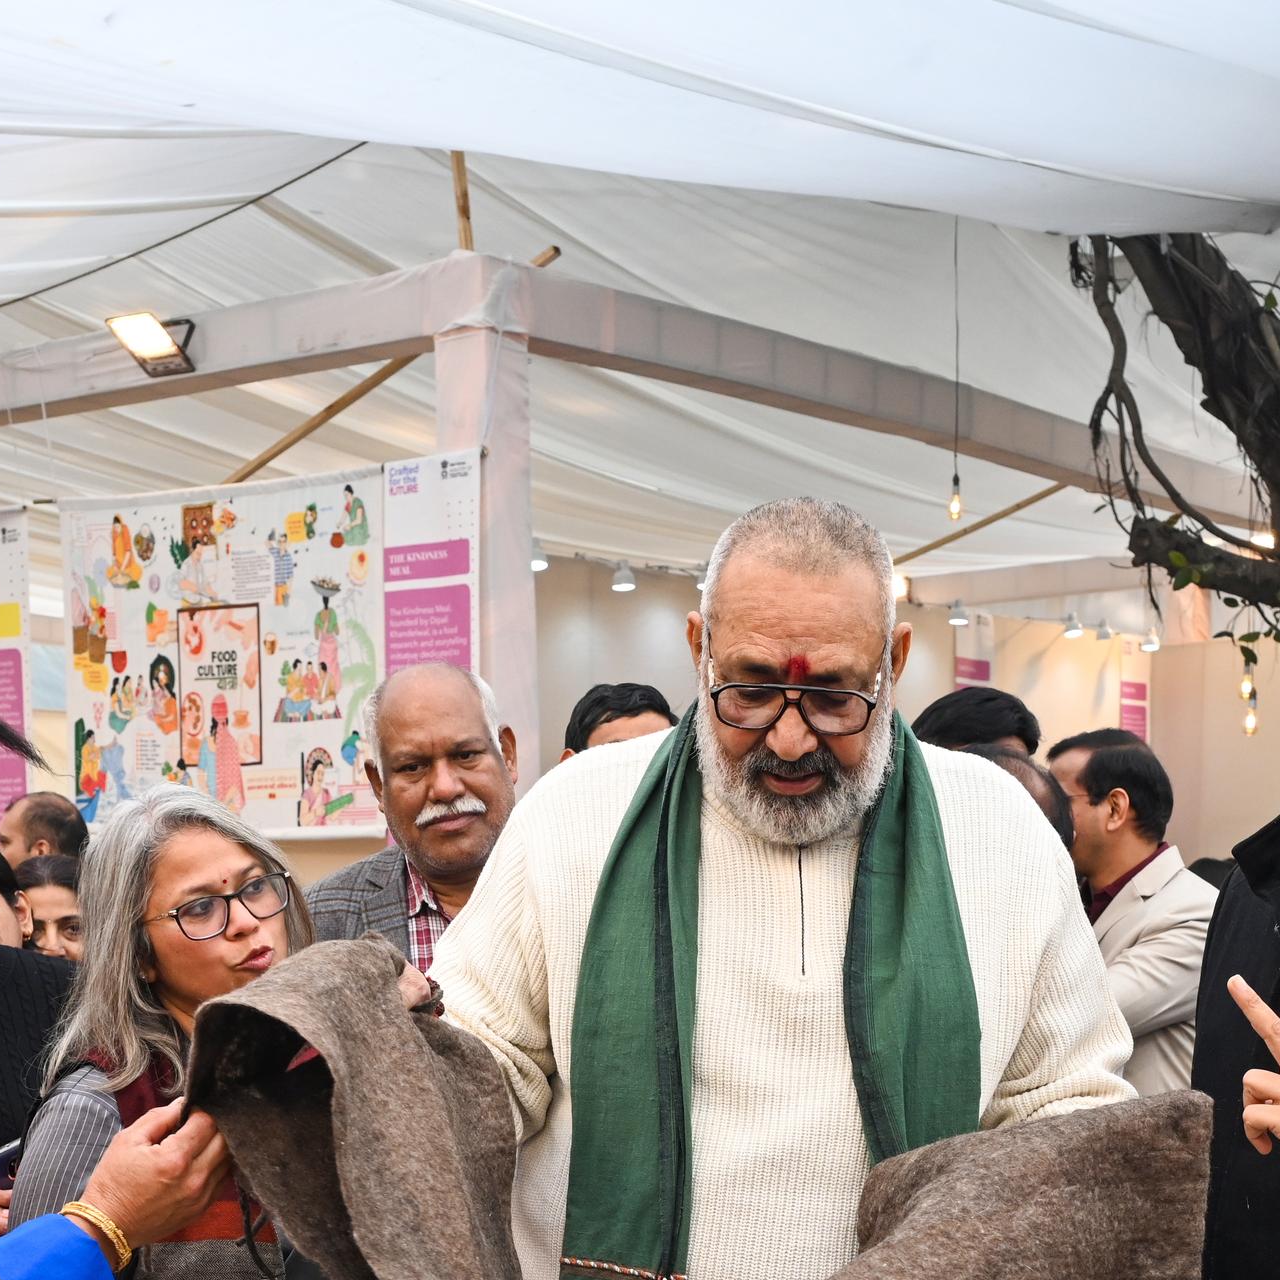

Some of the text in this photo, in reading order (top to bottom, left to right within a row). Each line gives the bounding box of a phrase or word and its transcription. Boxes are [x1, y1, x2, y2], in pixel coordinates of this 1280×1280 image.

[389, 463, 419, 477] Crafted
[389, 476, 400, 485] for
[389, 550, 448, 564] THE KINDNESS
[389, 565, 410, 576] MEAL
[211, 651, 237, 663] FOOD
[197, 664, 237, 677] CULTURE
